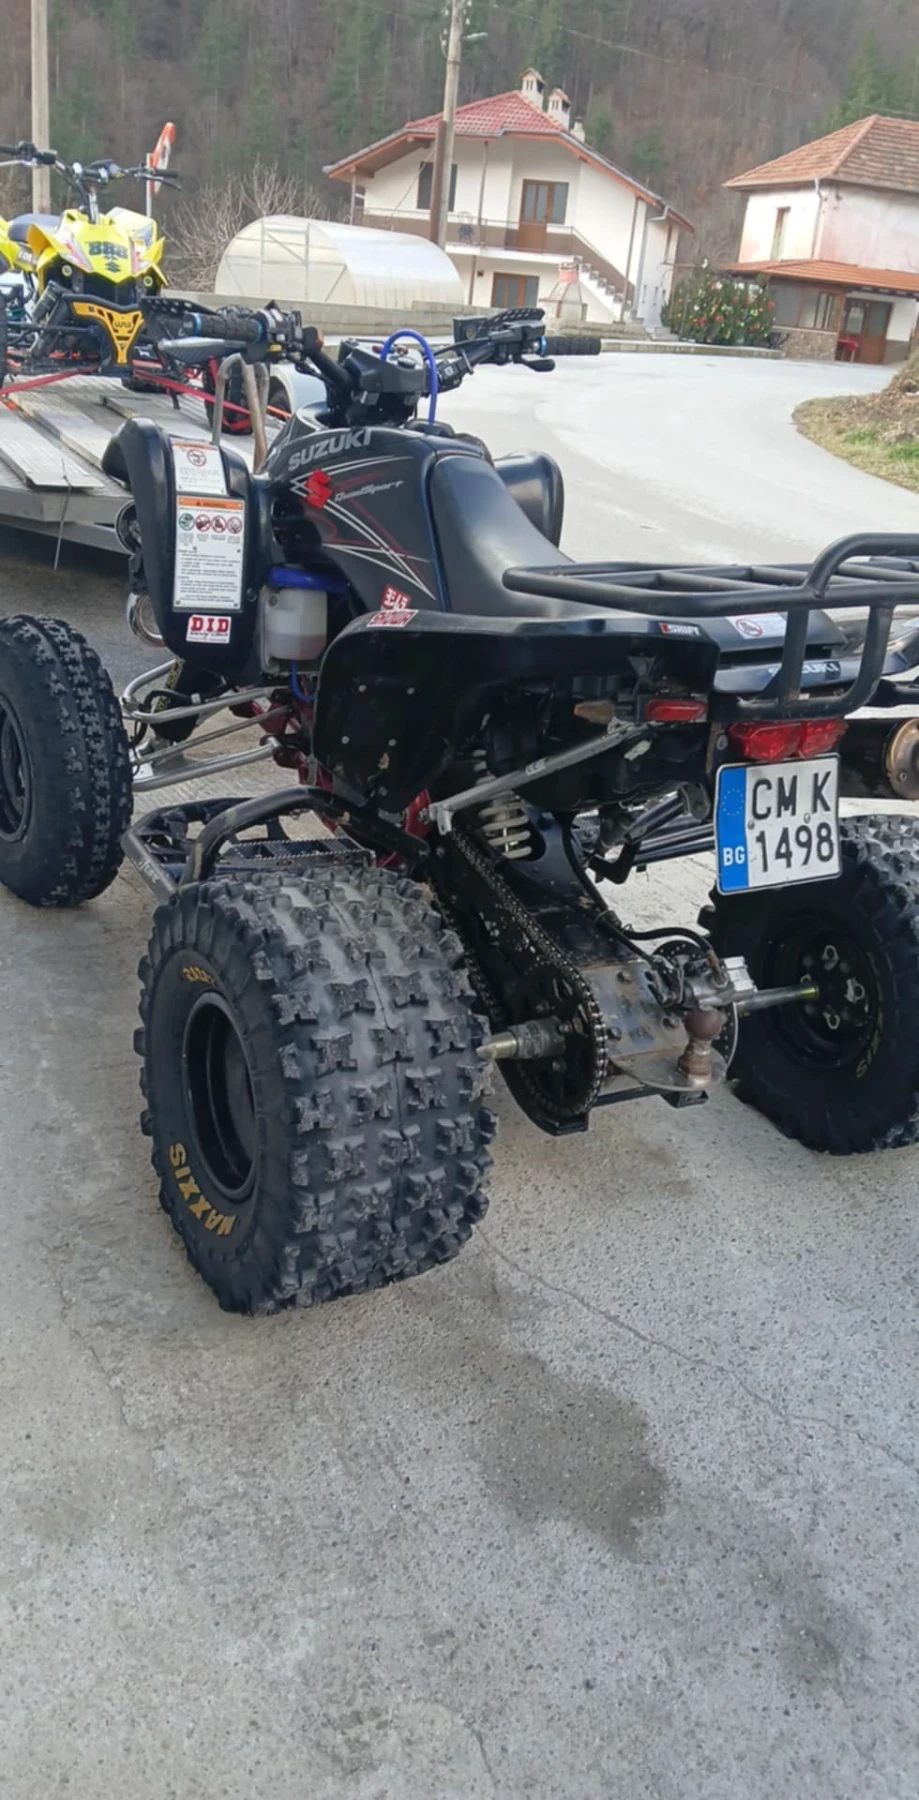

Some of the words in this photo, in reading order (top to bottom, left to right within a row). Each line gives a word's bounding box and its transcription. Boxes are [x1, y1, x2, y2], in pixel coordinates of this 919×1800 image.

[288, 428, 373, 471] SUZUKI
[752, 775, 797, 820] CM
[811, 771, 832, 814] K
[723, 846, 745, 866] BG
[755, 822, 834, 872] 1498
[169, 1143, 237, 1236] MAXXIS
